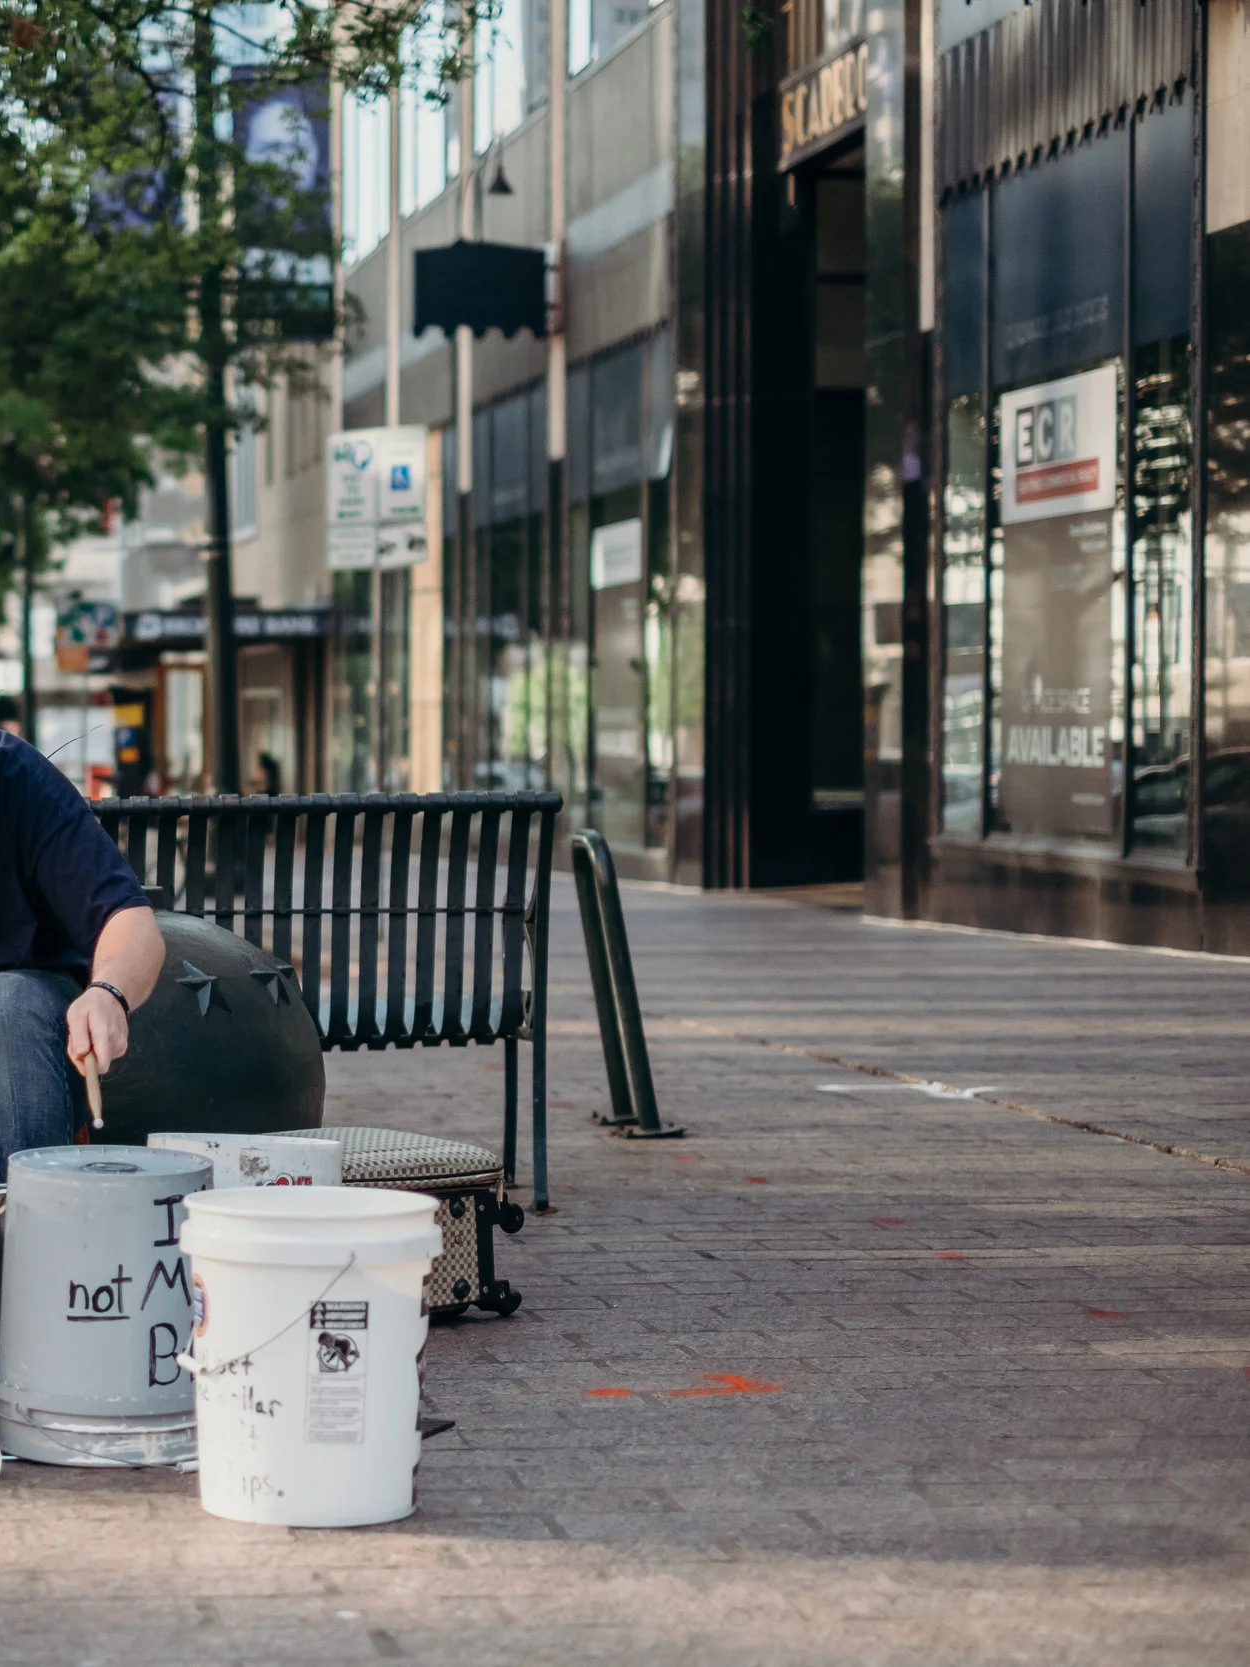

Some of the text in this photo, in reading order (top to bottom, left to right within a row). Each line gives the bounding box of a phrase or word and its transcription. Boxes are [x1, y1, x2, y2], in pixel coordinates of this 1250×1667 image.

[1017, 401, 1076, 463] ECR
[1007, 725, 1105, 768] AVAILABLE
[68, 1264, 133, 1314] not
